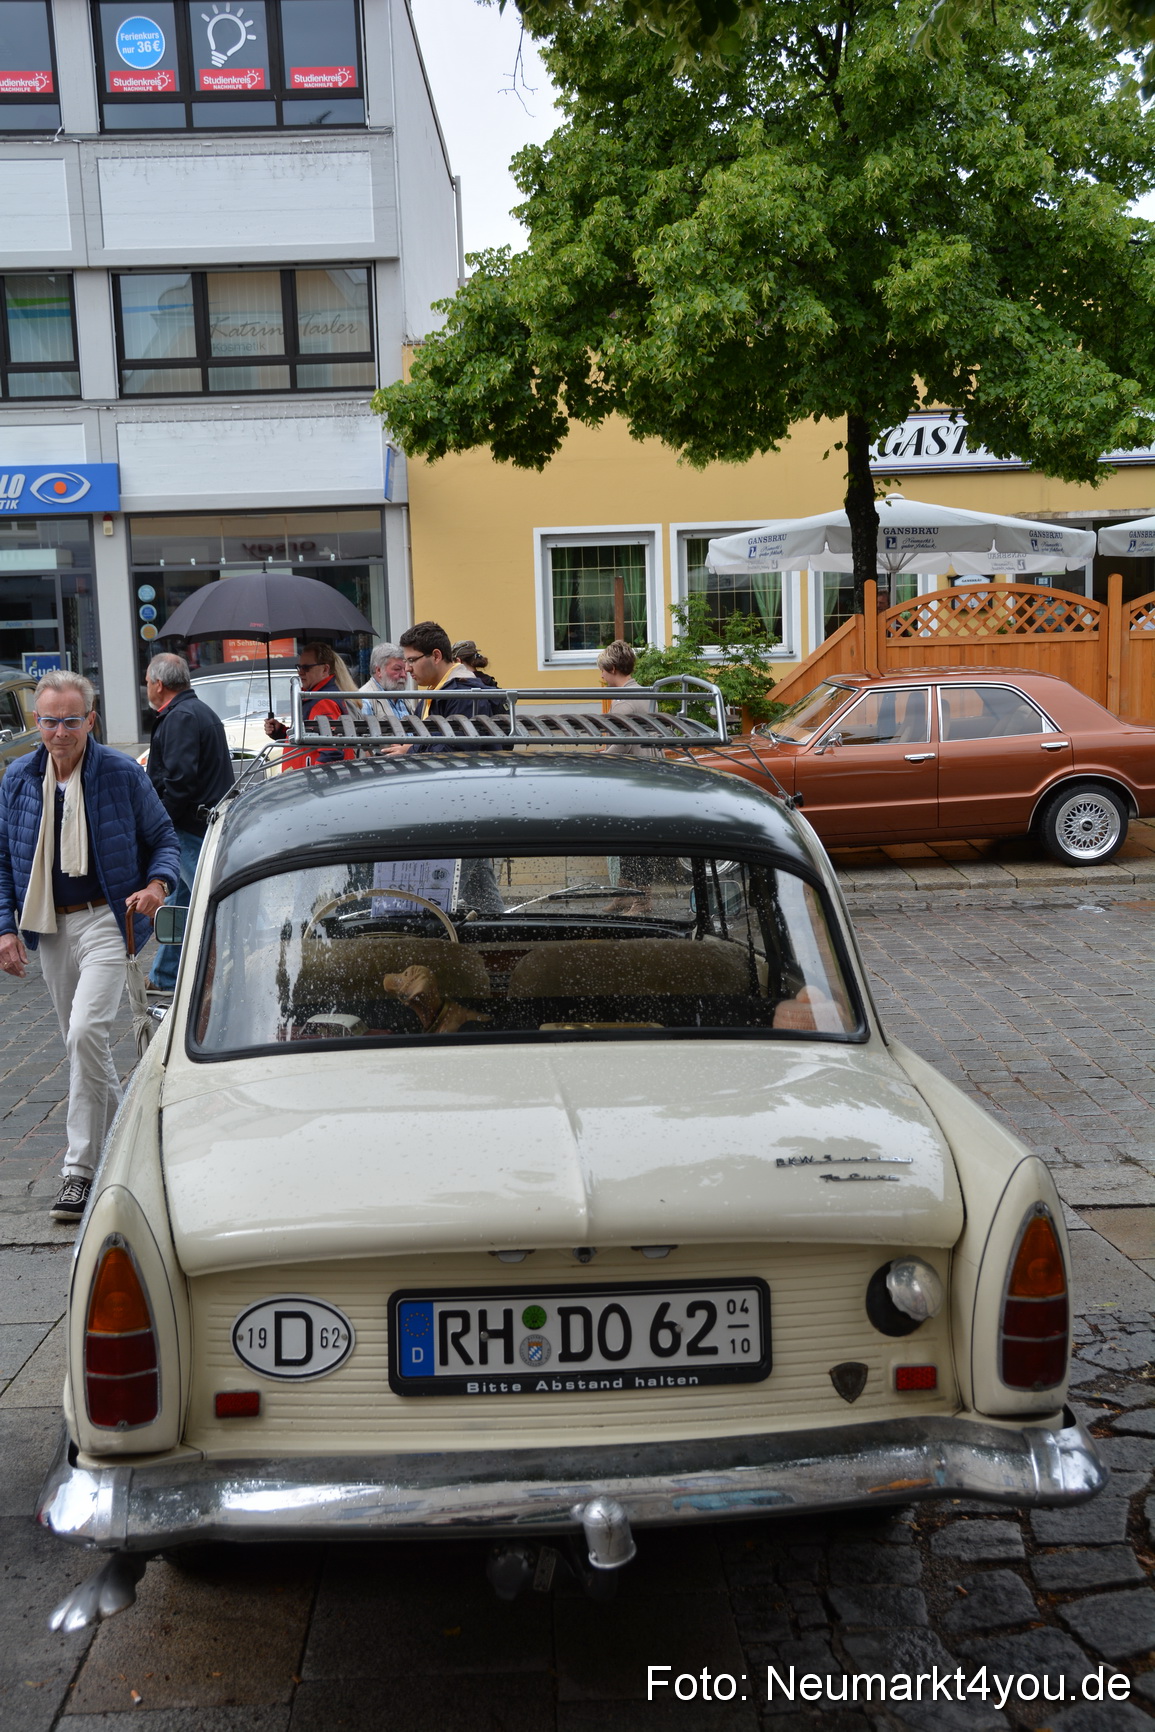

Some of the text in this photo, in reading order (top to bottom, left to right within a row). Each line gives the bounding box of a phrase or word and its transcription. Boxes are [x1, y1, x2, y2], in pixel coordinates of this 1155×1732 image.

[120, 32, 160, 41] Ferienkurs
[122, 46, 135, 54] nur
[113, 77, 162, 87] Studienkreis
[203, 75, 251, 85] Studienkreis
[294, 73, 342, 83] Studienkreis
[210, 313, 358, 339] Katrin Tasler
[212, 342, 266, 352] Kosmetik
[882, 526, 939, 536] GANSBRÄU
[726, 1298, 750, 1315] 04
[411, 1347, 424, 1363] D
[438, 1307, 515, 1367] RH
[649, 1299, 719, 1359] 62
[247, 1310, 340, 1367] 19 D 62
[730, 1337, 751, 1355] 10
[466, 1375, 700, 1394] Bitte Abstand halten
